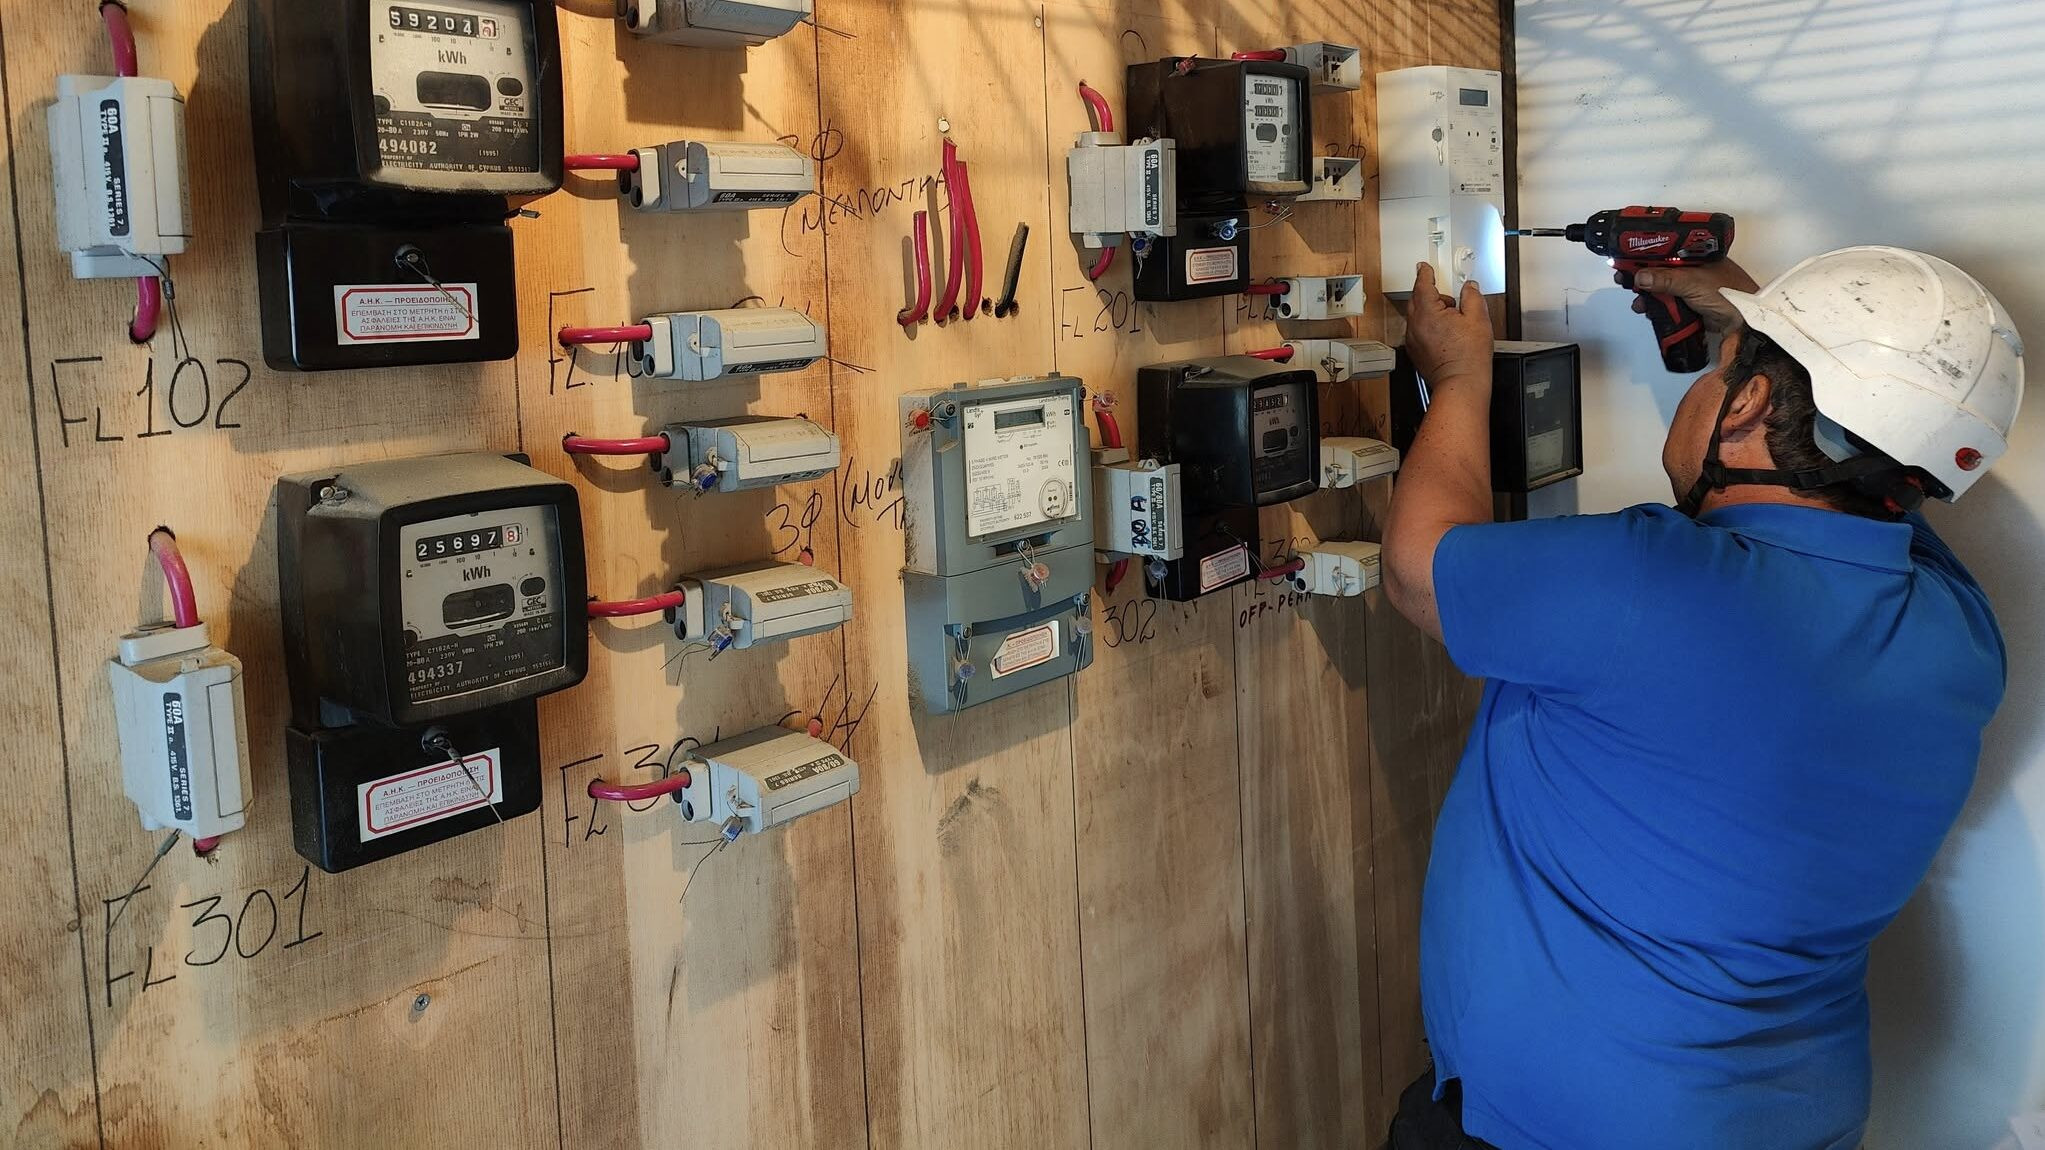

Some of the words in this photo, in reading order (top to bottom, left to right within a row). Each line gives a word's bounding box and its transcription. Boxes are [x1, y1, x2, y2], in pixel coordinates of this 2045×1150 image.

[438, 50, 467, 64] kWh
[504, 98, 519, 106] GEC
[100, 109, 109, 135] TYPE
[107, 107, 119, 134] 60A
[377, 118, 393, 126] TYPE
[379, 138, 437, 154] 494082
[381, 161, 423, 169] ELECTRICITY
[430, 163, 463, 171] AUTHORITY
[113, 177, 124, 215] SERIES
[1628, 235, 1670, 249] Milwaukee
[463, 566, 491, 581] kWh
[527, 597, 541, 605] GEC
[408, 661, 463, 684] 494337
[410, 686, 450, 699] ELECTRICITY
[457, 675, 489, 688] AUTHORITY
[504, 667, 526, 676] CYPRUS
[165, 702, 174, 725] TYPE
[172, 701, 183, 725] 60A
[179, 767, 189, 802] SERIES
[416, 789, 430, 800] ΣΤΟ
